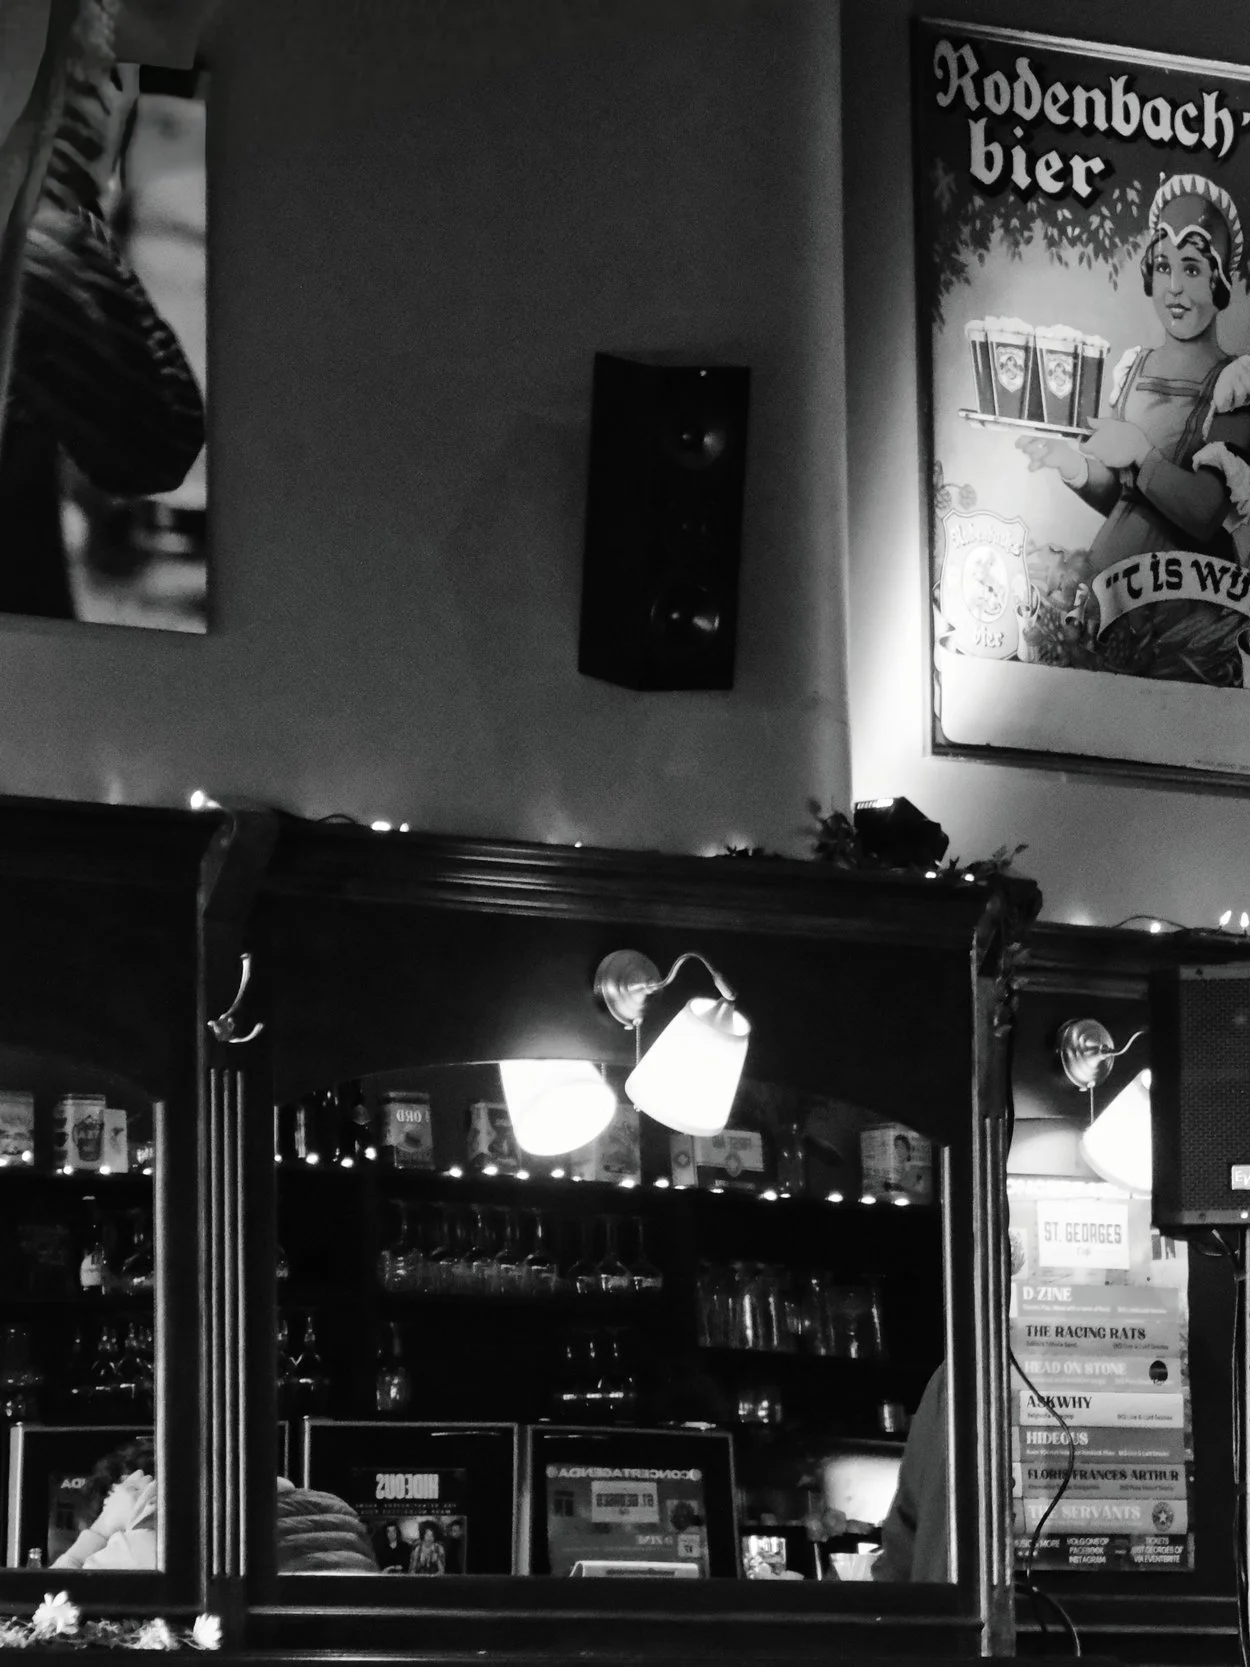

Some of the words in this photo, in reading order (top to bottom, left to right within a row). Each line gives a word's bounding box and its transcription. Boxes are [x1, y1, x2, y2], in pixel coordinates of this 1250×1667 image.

[967, 117, 1105, 199] bier
[1065, 1222, 1123, 1245] GEORGES
[1026, 1324, 1051, 1338] THE
[1055, 1325, 1107, 1340] RACING
[1109, 1326, 1147, 1341] RATS
[1024, 1360, 1061, 1375] HEAD
[1063, 1361, 1081, 1375] ON
[1083, 1361, 1127, 1376] STONE
[1025, 1430, 1089, 1446] HIDEOUS
[1071, 1469, 1128, 1482] FRANCES
[1130, 1469, 1180, 1483] ARTHUR
[1061, 1504, 1141, 1520] SERVANTS
